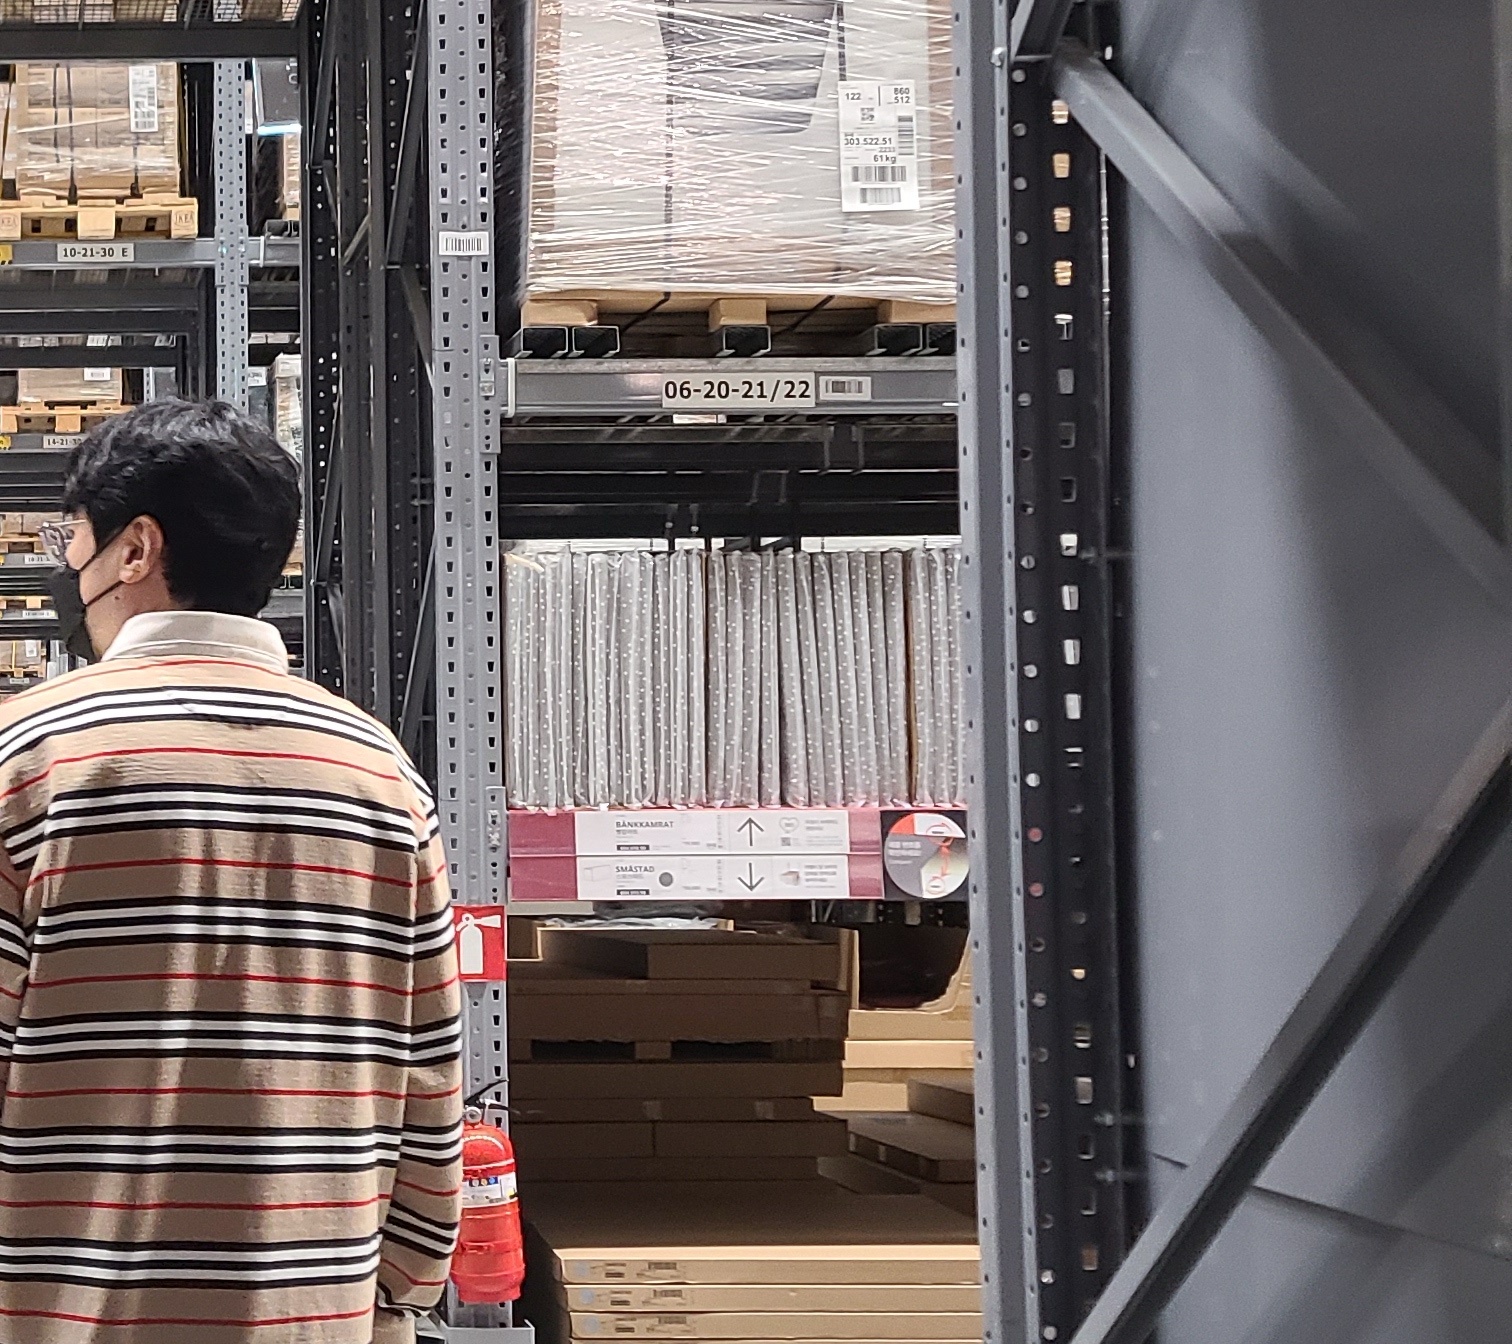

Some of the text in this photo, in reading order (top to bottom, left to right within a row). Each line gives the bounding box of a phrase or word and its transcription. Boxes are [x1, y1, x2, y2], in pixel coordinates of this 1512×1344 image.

[845, 92, 861, 101] 122
[893, 96, 911, 104] 512
[62, 247, 129, 258] 10-21-30 E
[663, 378, 811, 403] 06-20-21/22
